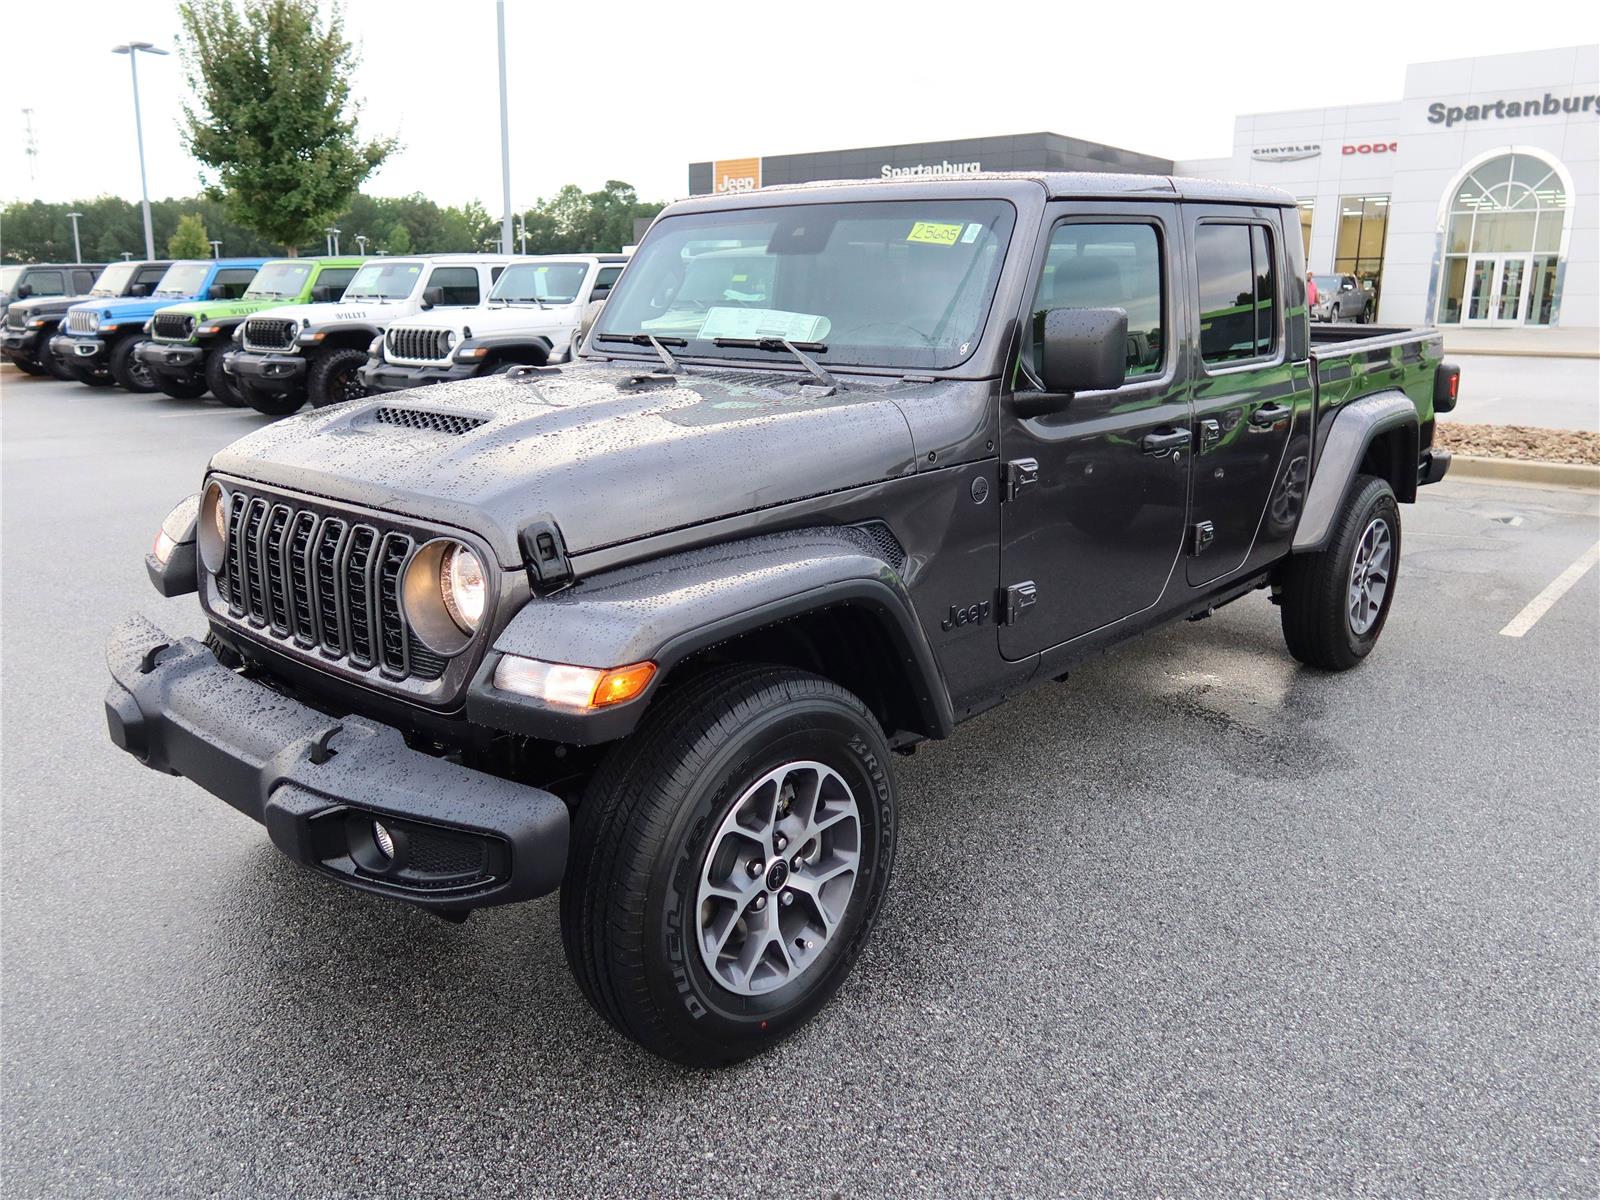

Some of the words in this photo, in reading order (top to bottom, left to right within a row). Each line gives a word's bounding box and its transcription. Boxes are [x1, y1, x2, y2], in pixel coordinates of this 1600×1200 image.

[1253, 144, 1320, 154] CHRYSLER
[718, 174, 754, 192] Jeep
[911, 223, 958, 241] 25605
[941, 601, 990, 632] Jeep
